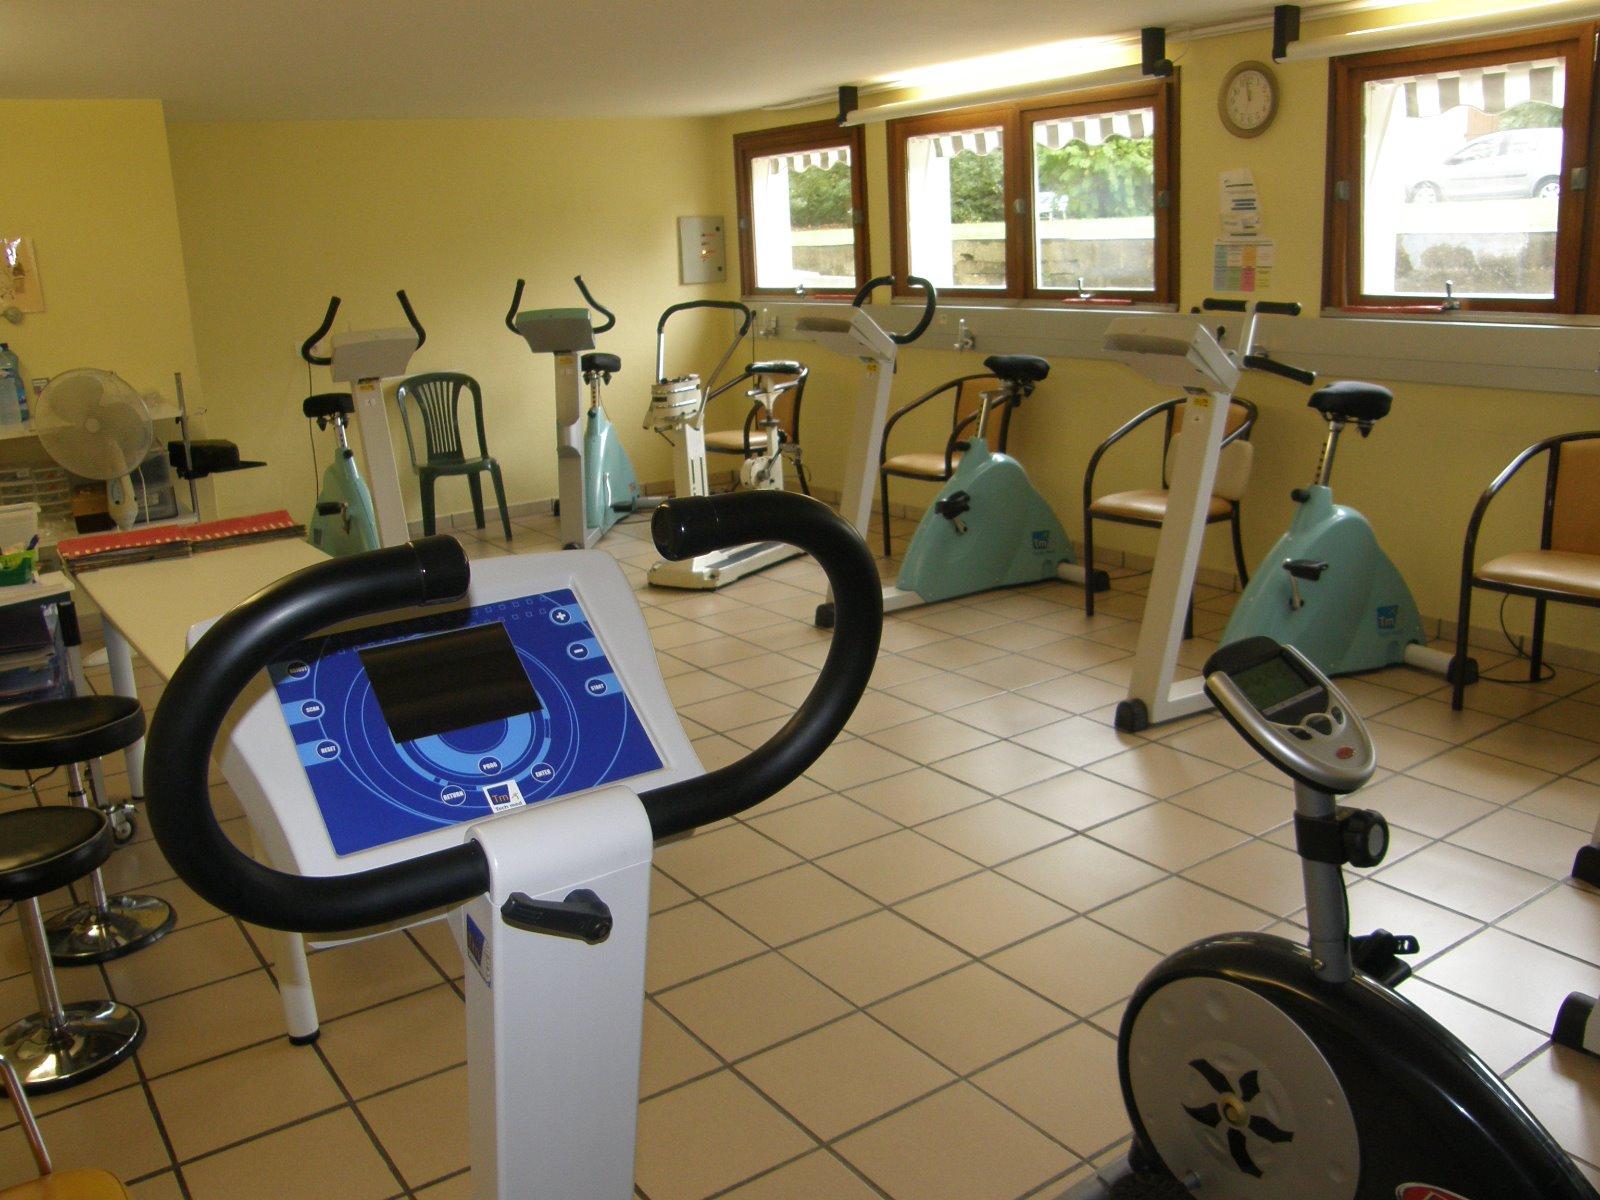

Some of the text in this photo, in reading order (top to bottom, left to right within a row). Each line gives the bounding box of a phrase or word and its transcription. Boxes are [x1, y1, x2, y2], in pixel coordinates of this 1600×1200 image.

[305, 705, 320, 713] SCAN
[320, 745, 336, 754] RESET
[482, 761, 498, 770] PROG
[535, 769, 551, 778] ENTER
[443, 790, 464, 801] RETURN
[492, 794, 509, 803] Tm
